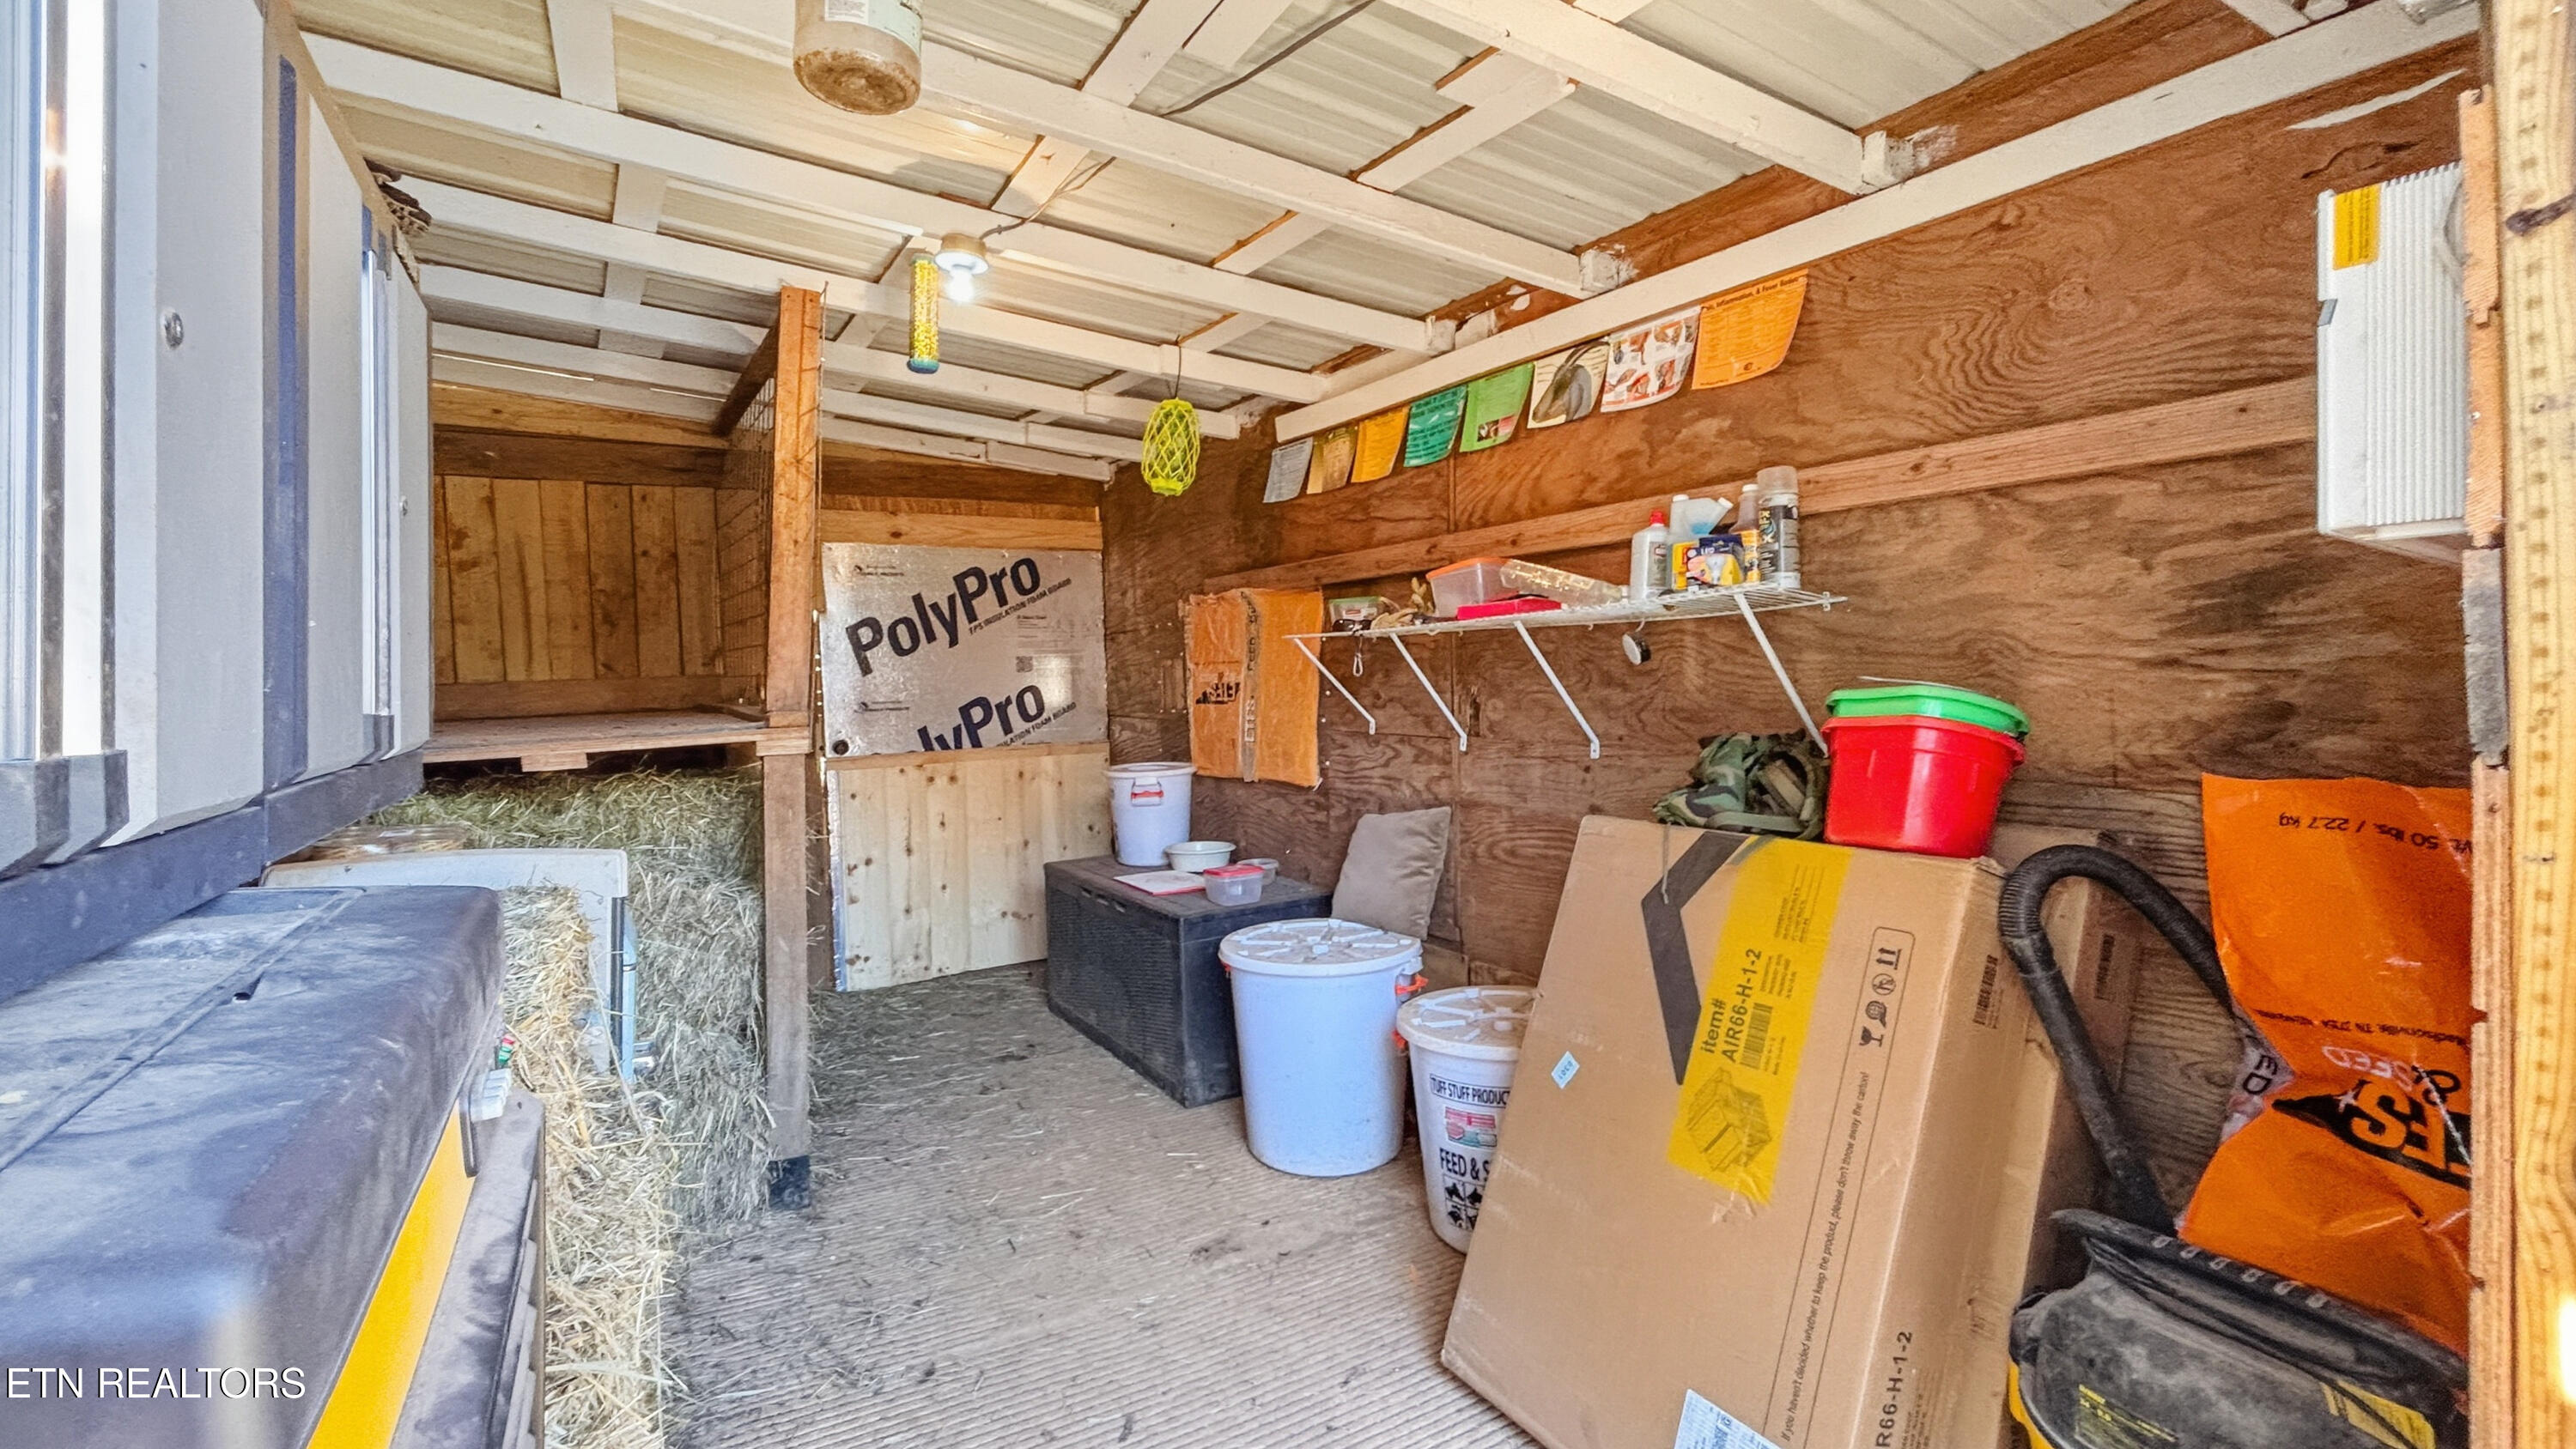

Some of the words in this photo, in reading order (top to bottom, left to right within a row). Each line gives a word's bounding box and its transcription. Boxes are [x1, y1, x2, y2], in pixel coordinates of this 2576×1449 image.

[1026, 590, 1048, 604] FOAM
[846, 557, 1041, 676] PolyPro
[871, 685, 1045, 755] lyPro
[1031, 716, 1053, 731] FOAM
[2278, 811, 2300, 828] kg
[2409, 833, 2439, 849] 50
[1721, 948, 1762, 1064] AIR66-H-1-2
[1700, 998, 1726, 1054] item#
[2322, 1046, 2414, 1092] SEED
[1431, 1077, 1447, 1093] TUFF
[1448, 1083, 1470, 1100] STUFF
[1853, 1102, 1862, 1115] the
[1849, 1119, 1862, 1140] away
[2350, 1079, 2470, 1175] FS
[1439, 1148, 1467, 1178] FEED
[1469, 1159, 1480, 1182] &
[1842, 1142, 1855, 1165] throw
[1837, 1165, 1849, 1187] don't
[1832, 1189, 1844, 1220] please
[1824, 1221, 1838, 1256] product,
[1819, 1255, 1830, 1270] the
[1813, 1272, 1827, 1294] keep
[1811, 1295, 1821, 1305] to
[1803, 1306, 1818, 1342] whether
[1795, 1343, 1810, 1379] decided
[1876, 1331, 1912, 1448] R66-H-1-2
[1784, 1416, 1795, 1434] you
